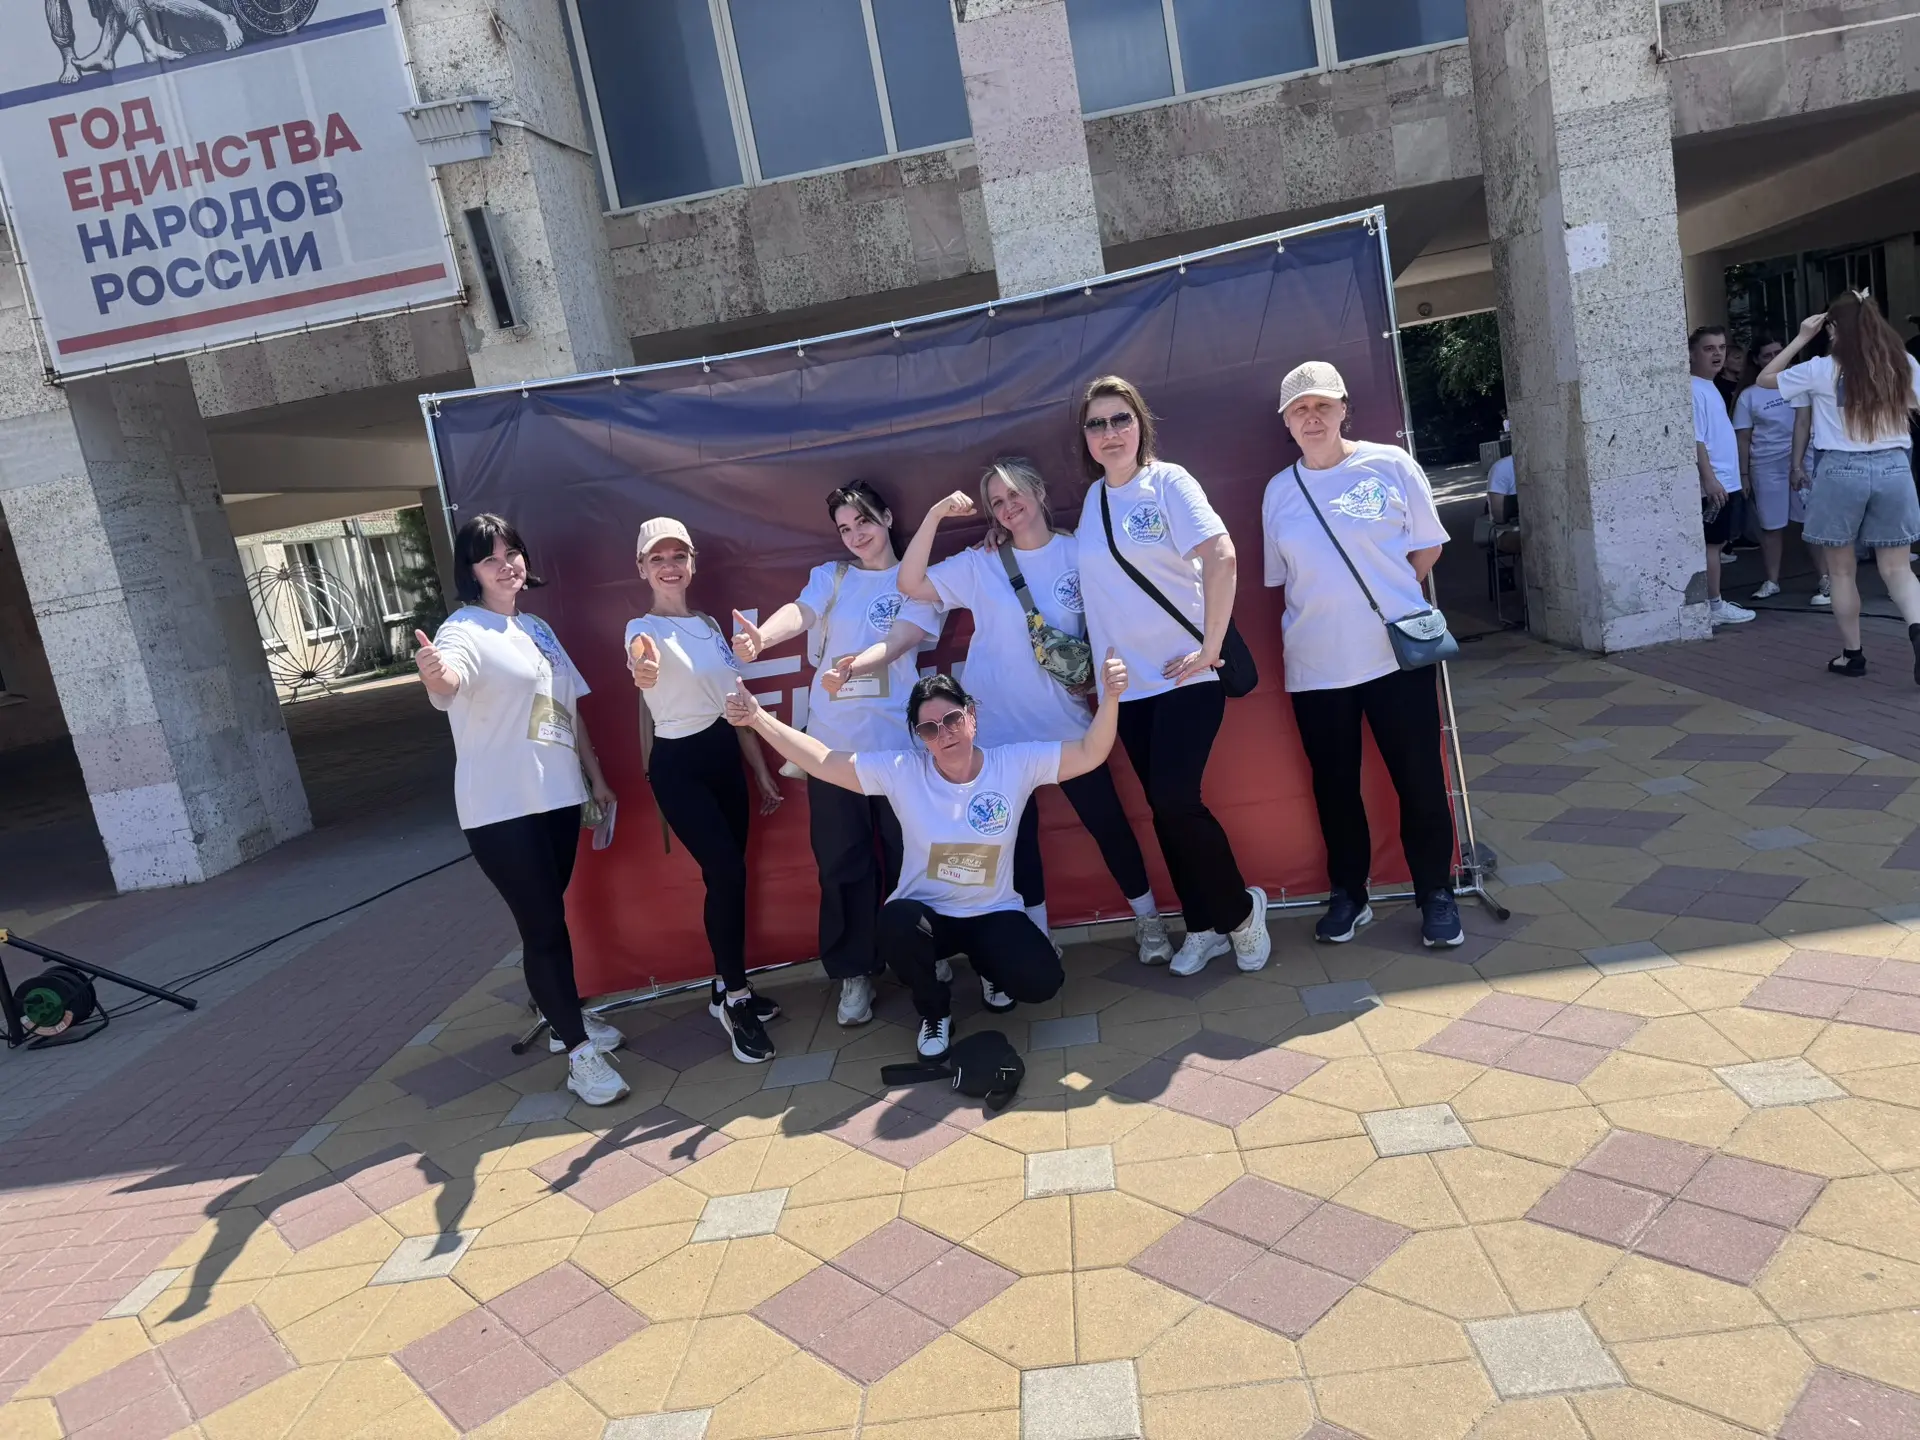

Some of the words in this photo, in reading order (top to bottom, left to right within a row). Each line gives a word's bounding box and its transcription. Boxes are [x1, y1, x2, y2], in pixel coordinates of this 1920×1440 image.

[48, 96, 164, 158] ГОД
[63, 112, 362, 212] ЕДИНСТВА
[77, 172, 344, 263] НАРОДОВ
[91, 230, 322, 315] РОССИИ
